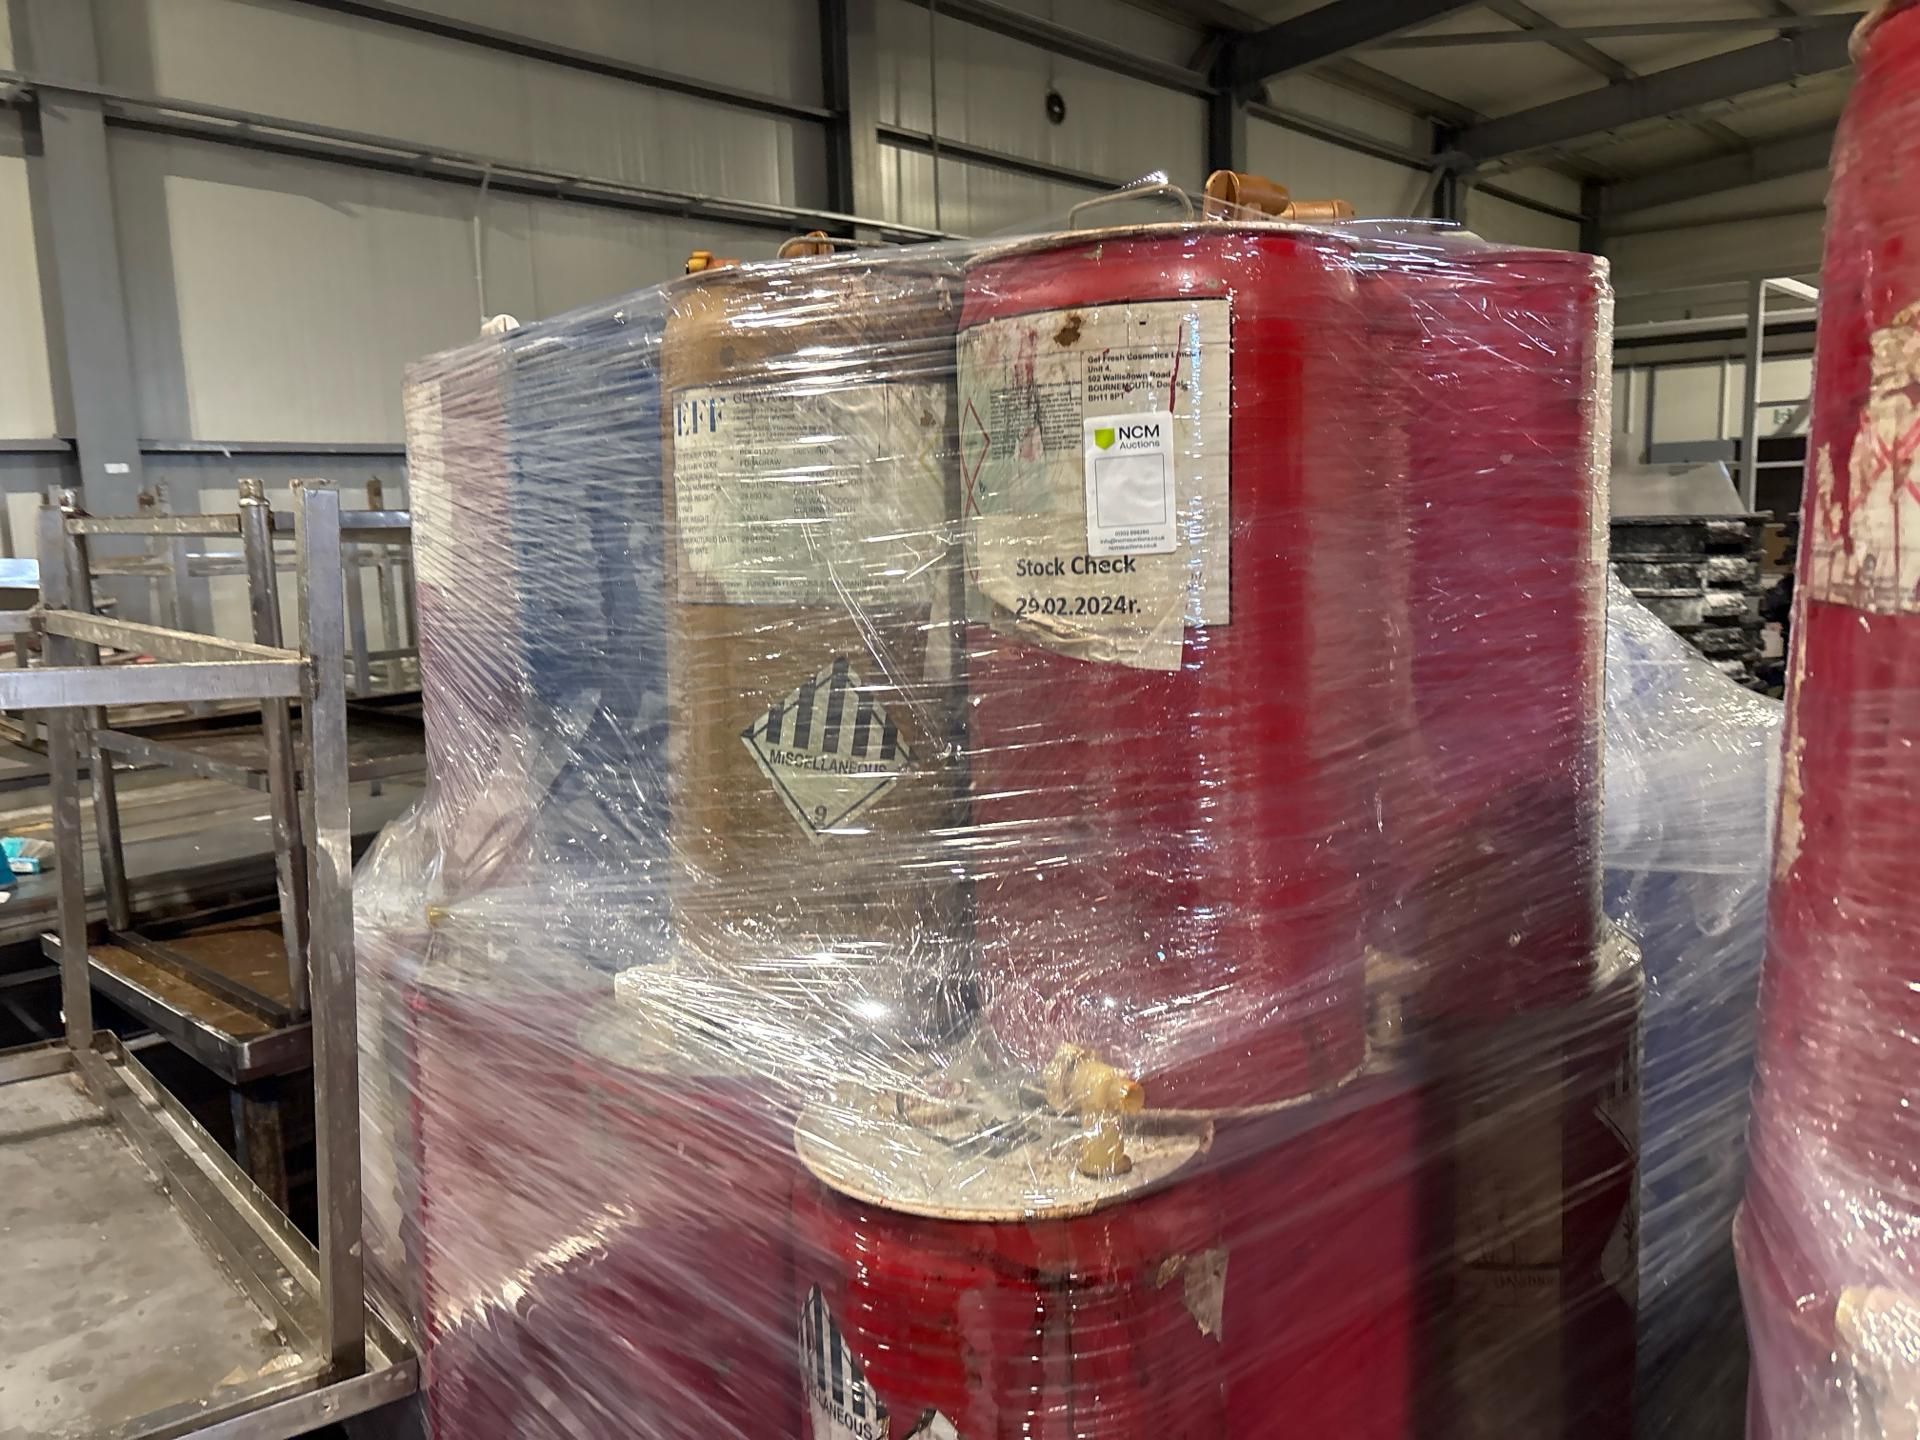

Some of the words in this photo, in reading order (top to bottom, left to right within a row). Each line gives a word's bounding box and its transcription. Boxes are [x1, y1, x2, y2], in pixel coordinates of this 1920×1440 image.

[1087, 355, 1102, 364] Get
[1087, 365, 1104, 373] Unit
[1149, 370, 1172, 378] Road
[1087, 394, 1109, 402] BH11
[1118, 424, 1160, 440] NCM
[1120, 439, 1161, 450] Auctions
[1016, 556, 1066, 577] Stock
[1070, 554, 1137, 575] Check
[1015, 595, 1142, 617] 29.02.2024r.
[769, 748, 888, 776] MISCELLANEOUS
[814, 804, 828, 829] 9
